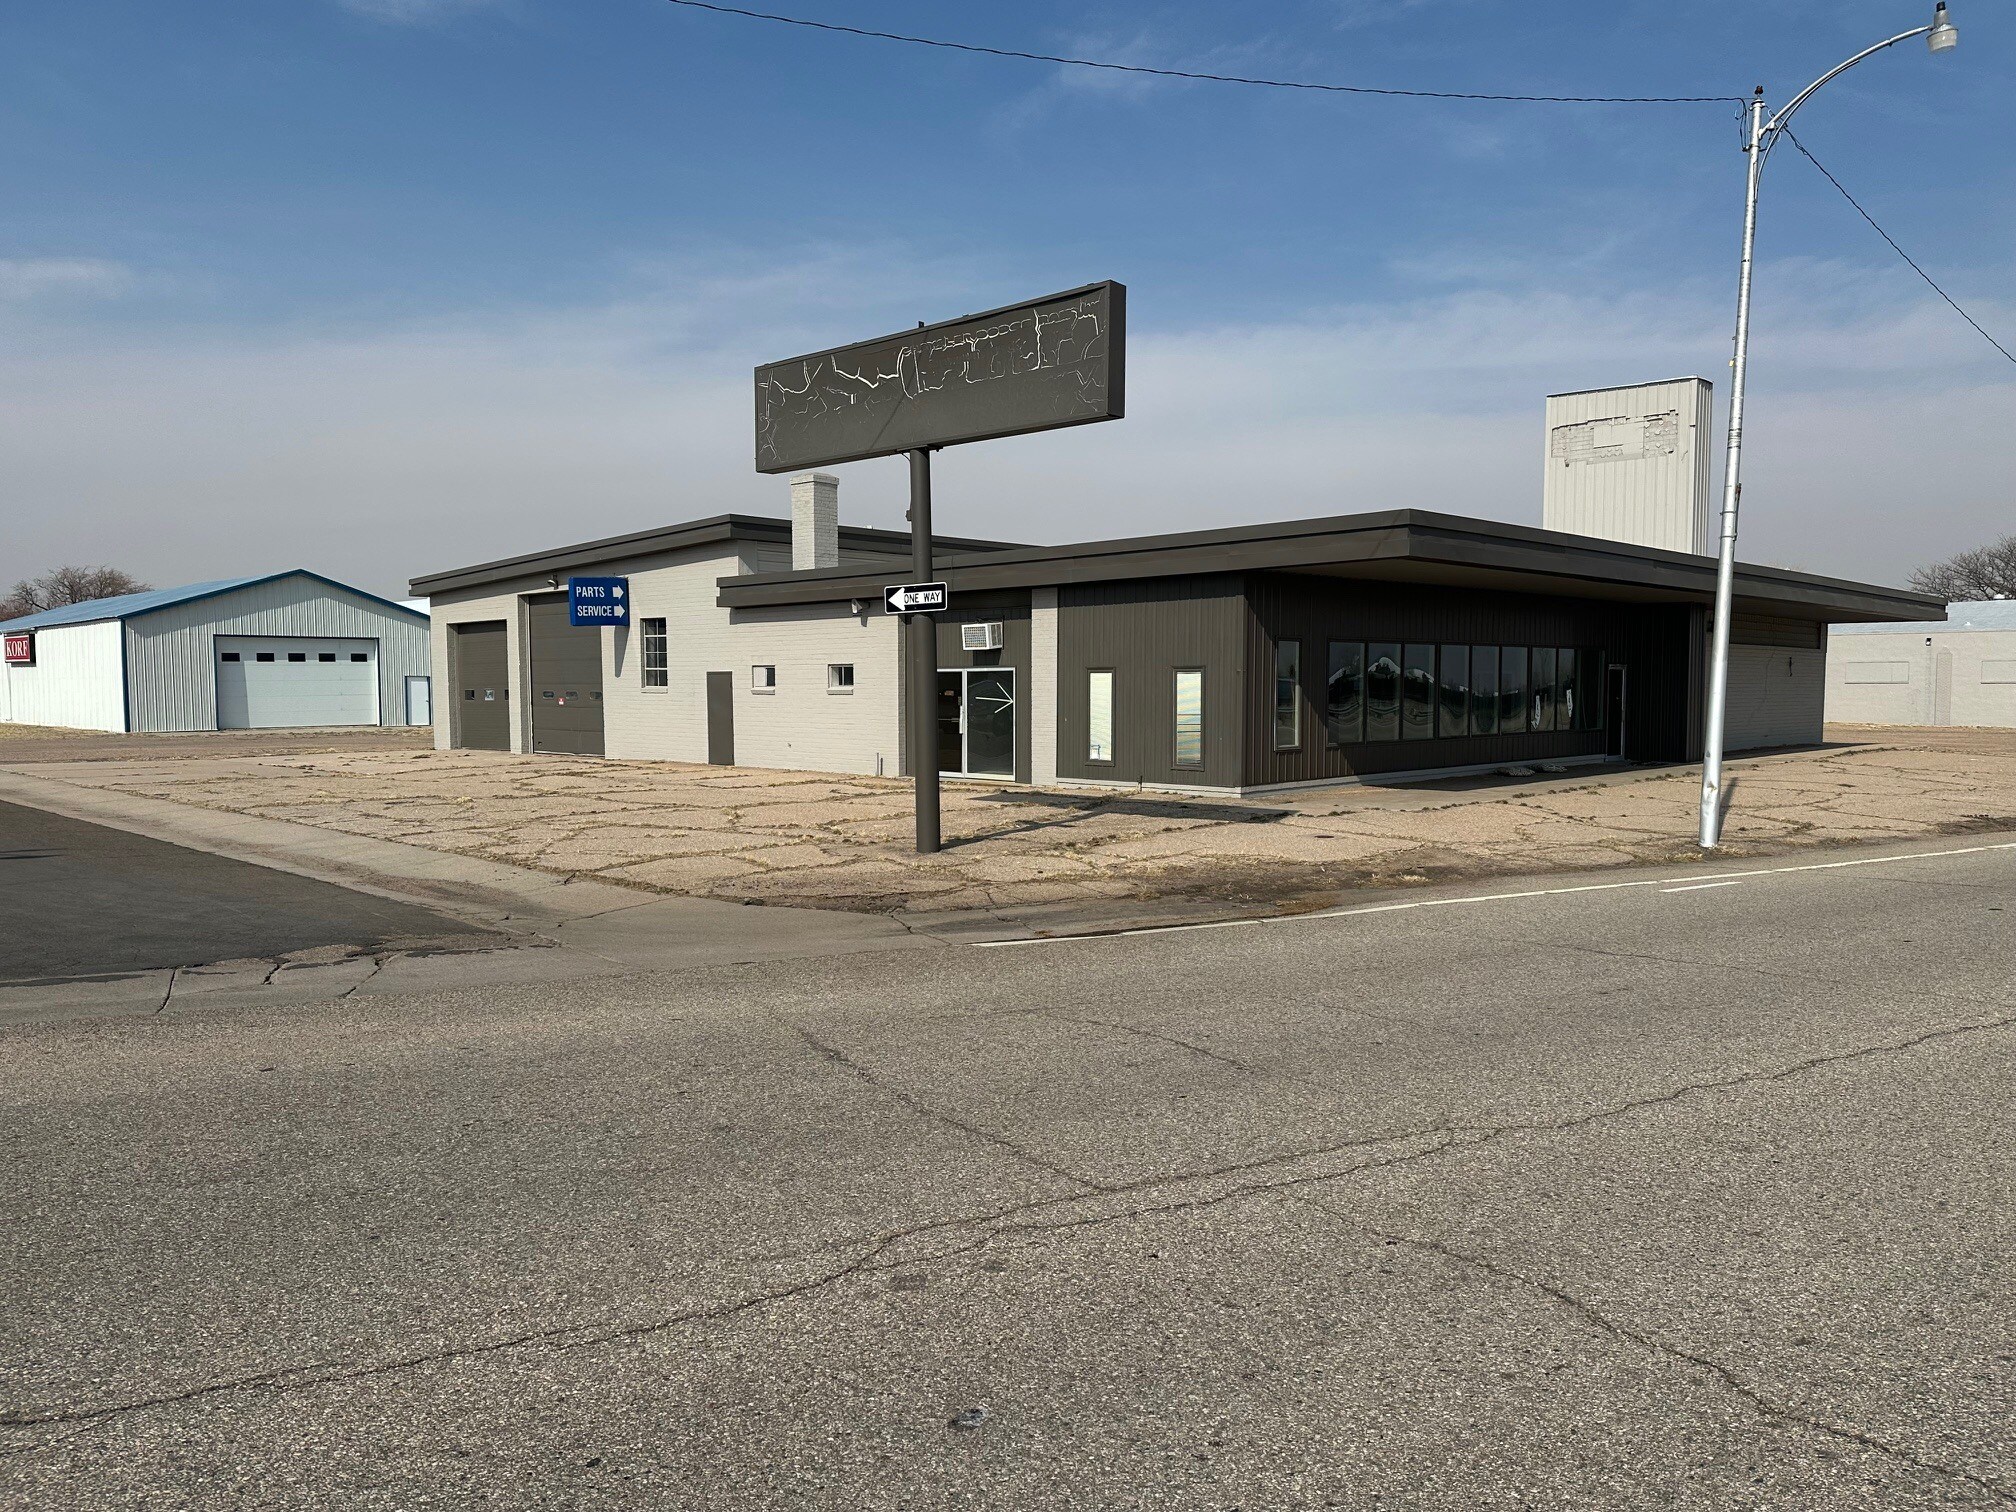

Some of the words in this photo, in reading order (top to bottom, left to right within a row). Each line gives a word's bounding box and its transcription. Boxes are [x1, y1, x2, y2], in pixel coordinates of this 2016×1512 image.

[576, 586, 605, 598] PARTS
[904, 593, 920, 604] ONE
[923, 591, 941, 603] WAY
[577, 605, 613, 617] SERVICE
[6, 640, 28, 657] KORF
